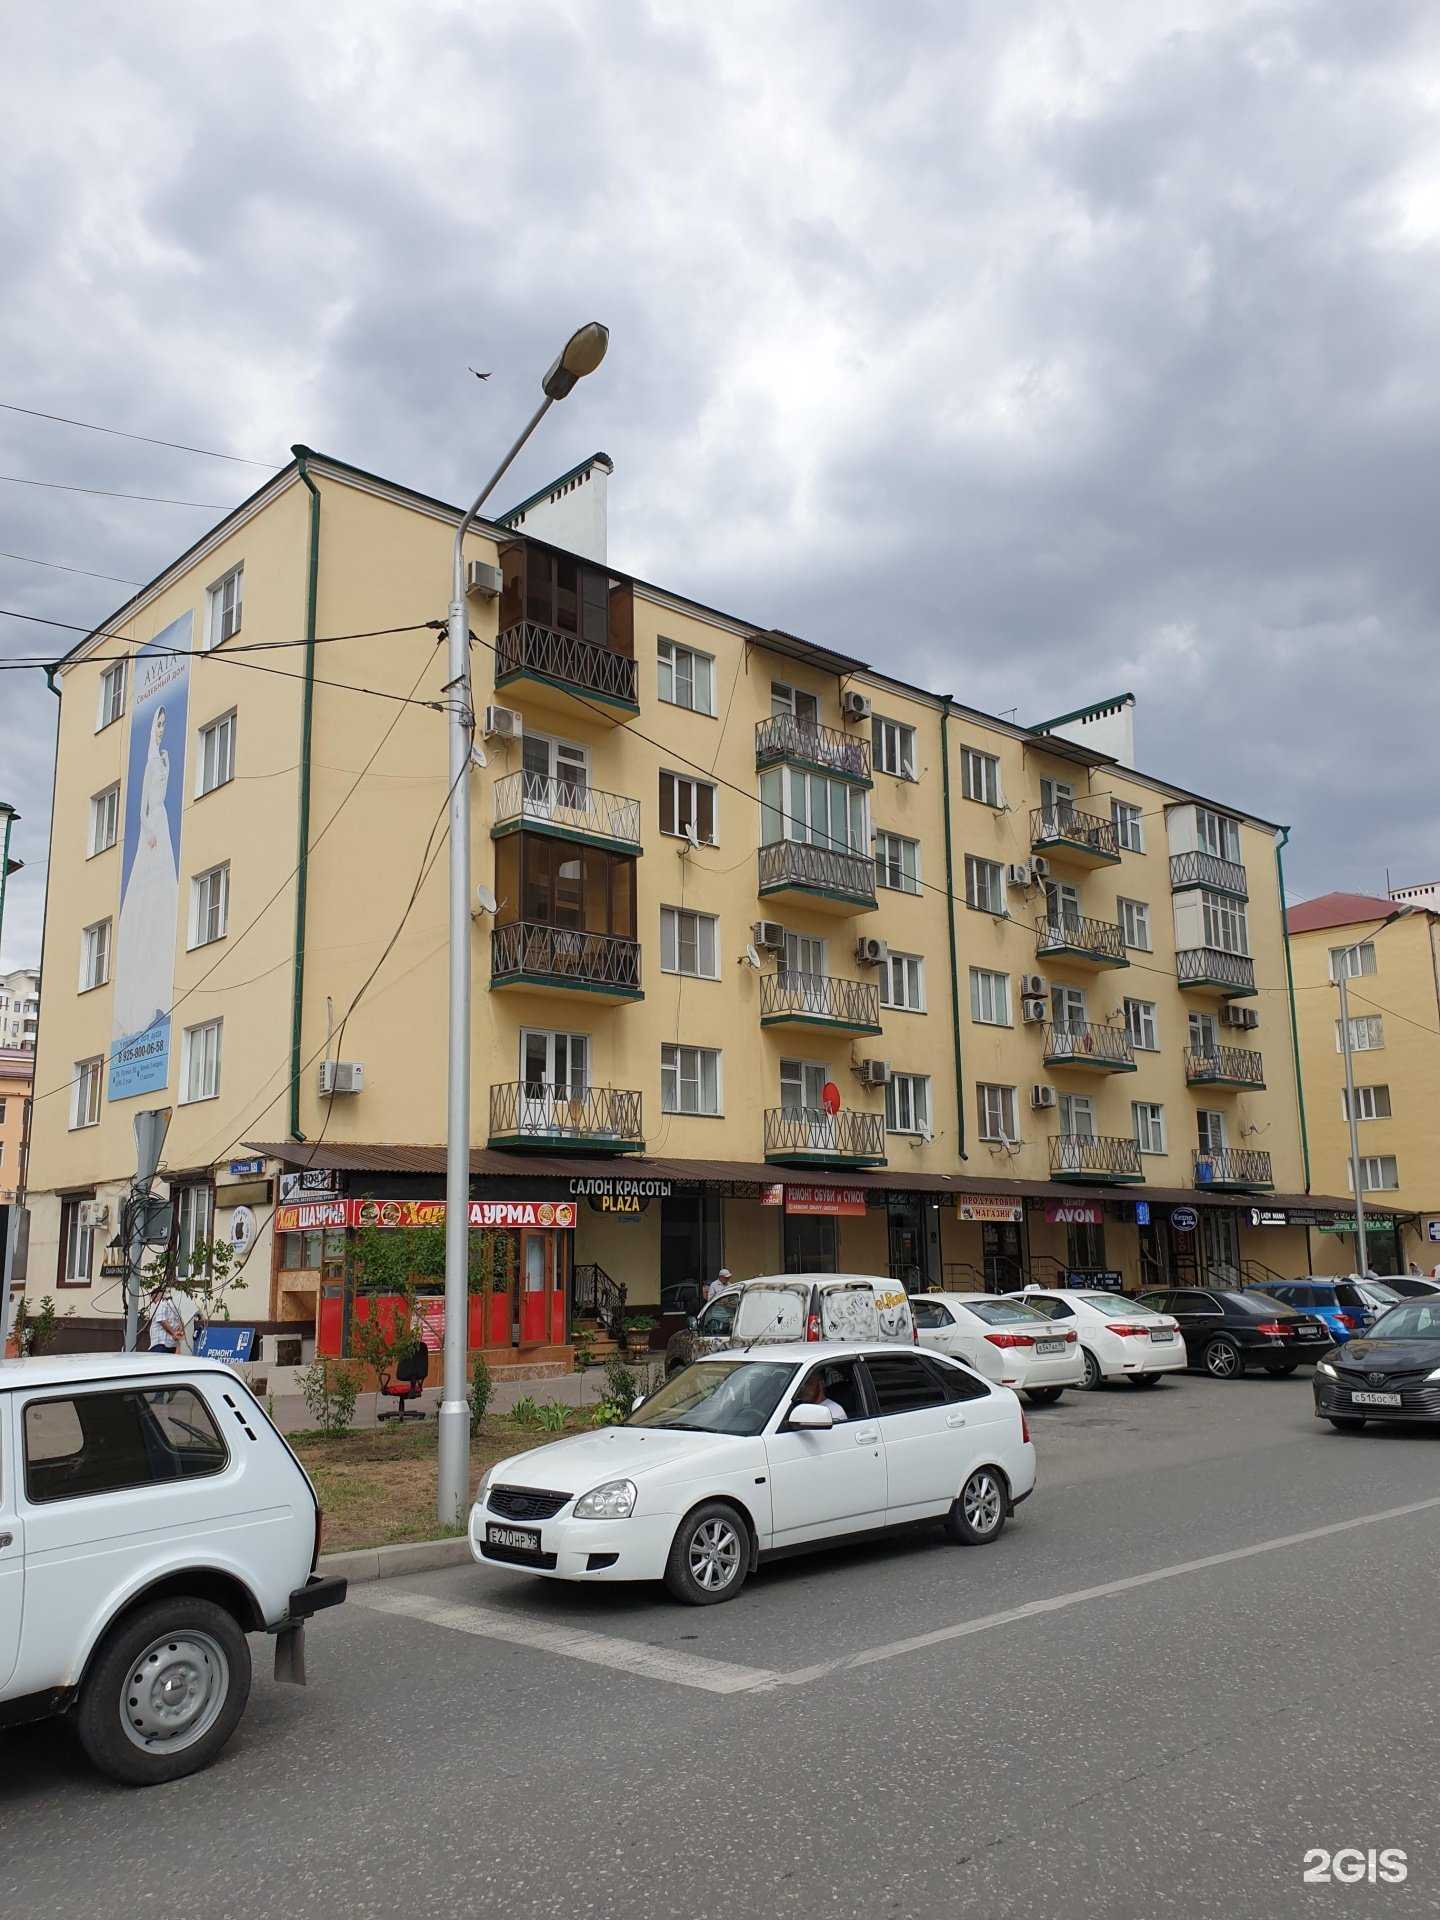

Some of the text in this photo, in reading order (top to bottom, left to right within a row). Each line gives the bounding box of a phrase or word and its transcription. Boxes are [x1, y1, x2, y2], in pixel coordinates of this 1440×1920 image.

[570, 1180, 671, 1196] САЛОН КРАСОТЫ
[788, 1187, 812, 1200] РЕМОНТ
[815, 1188, 835, 1201] ОБУВИ
[844, 1190, 864, 1203] СУМОК
[602, 1195, 640, 1212] PLAZA
[299, 1202, 344, 1226] ШАУРМА
[468, 1204, 535, 1224] АУРМА
[975, 1208, 1010, 1218] МАГАЗИН
[1055, 1208, 1095, 1222] AVON
[208, 1348, 233, 1357] РЕМОНТ
